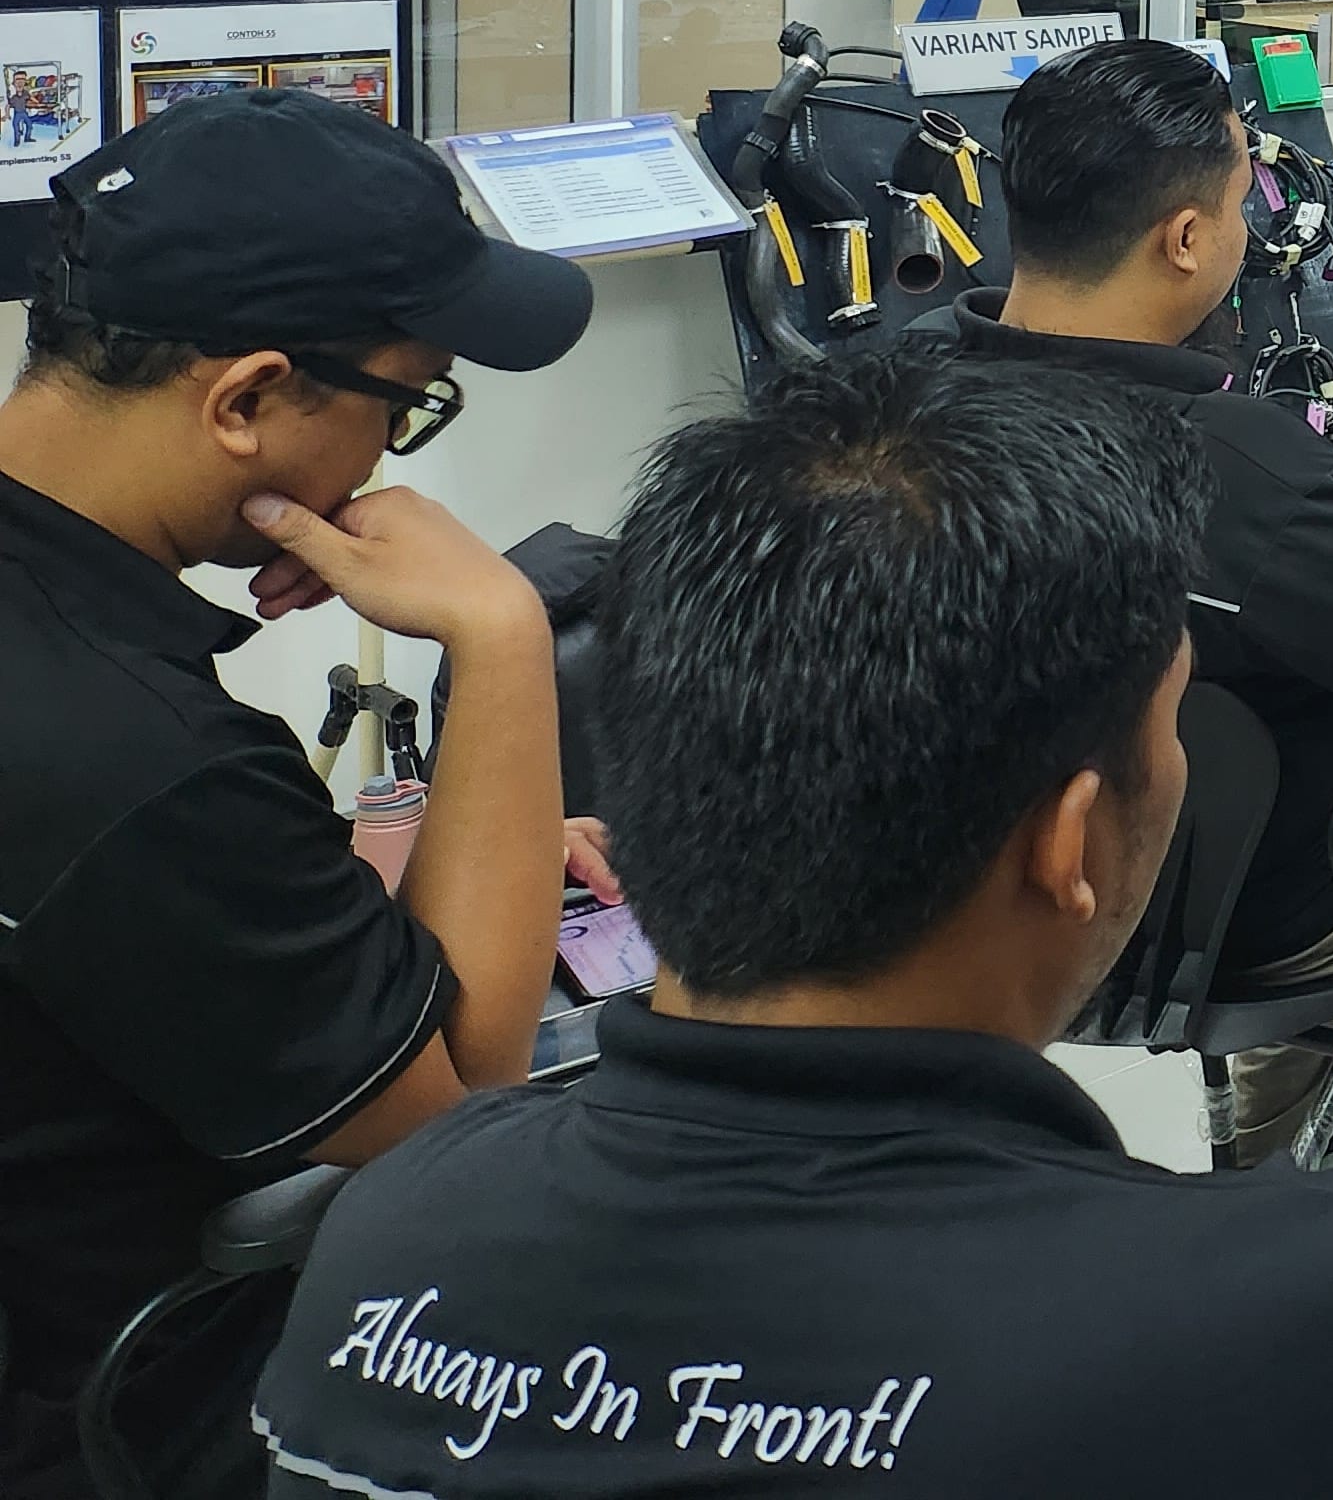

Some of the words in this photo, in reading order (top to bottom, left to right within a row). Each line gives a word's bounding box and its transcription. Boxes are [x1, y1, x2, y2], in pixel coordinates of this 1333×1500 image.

[226, 30, 264, 40] CONTOH
[911, 30, 1018, 57] VARIANT
[1024, 24, 1114, 50] SAMPLE
[329, 1287, 542, 1460] Always
[552, 1344, 641, 1442] In
[668, 1363, 933, 1471] Front!
